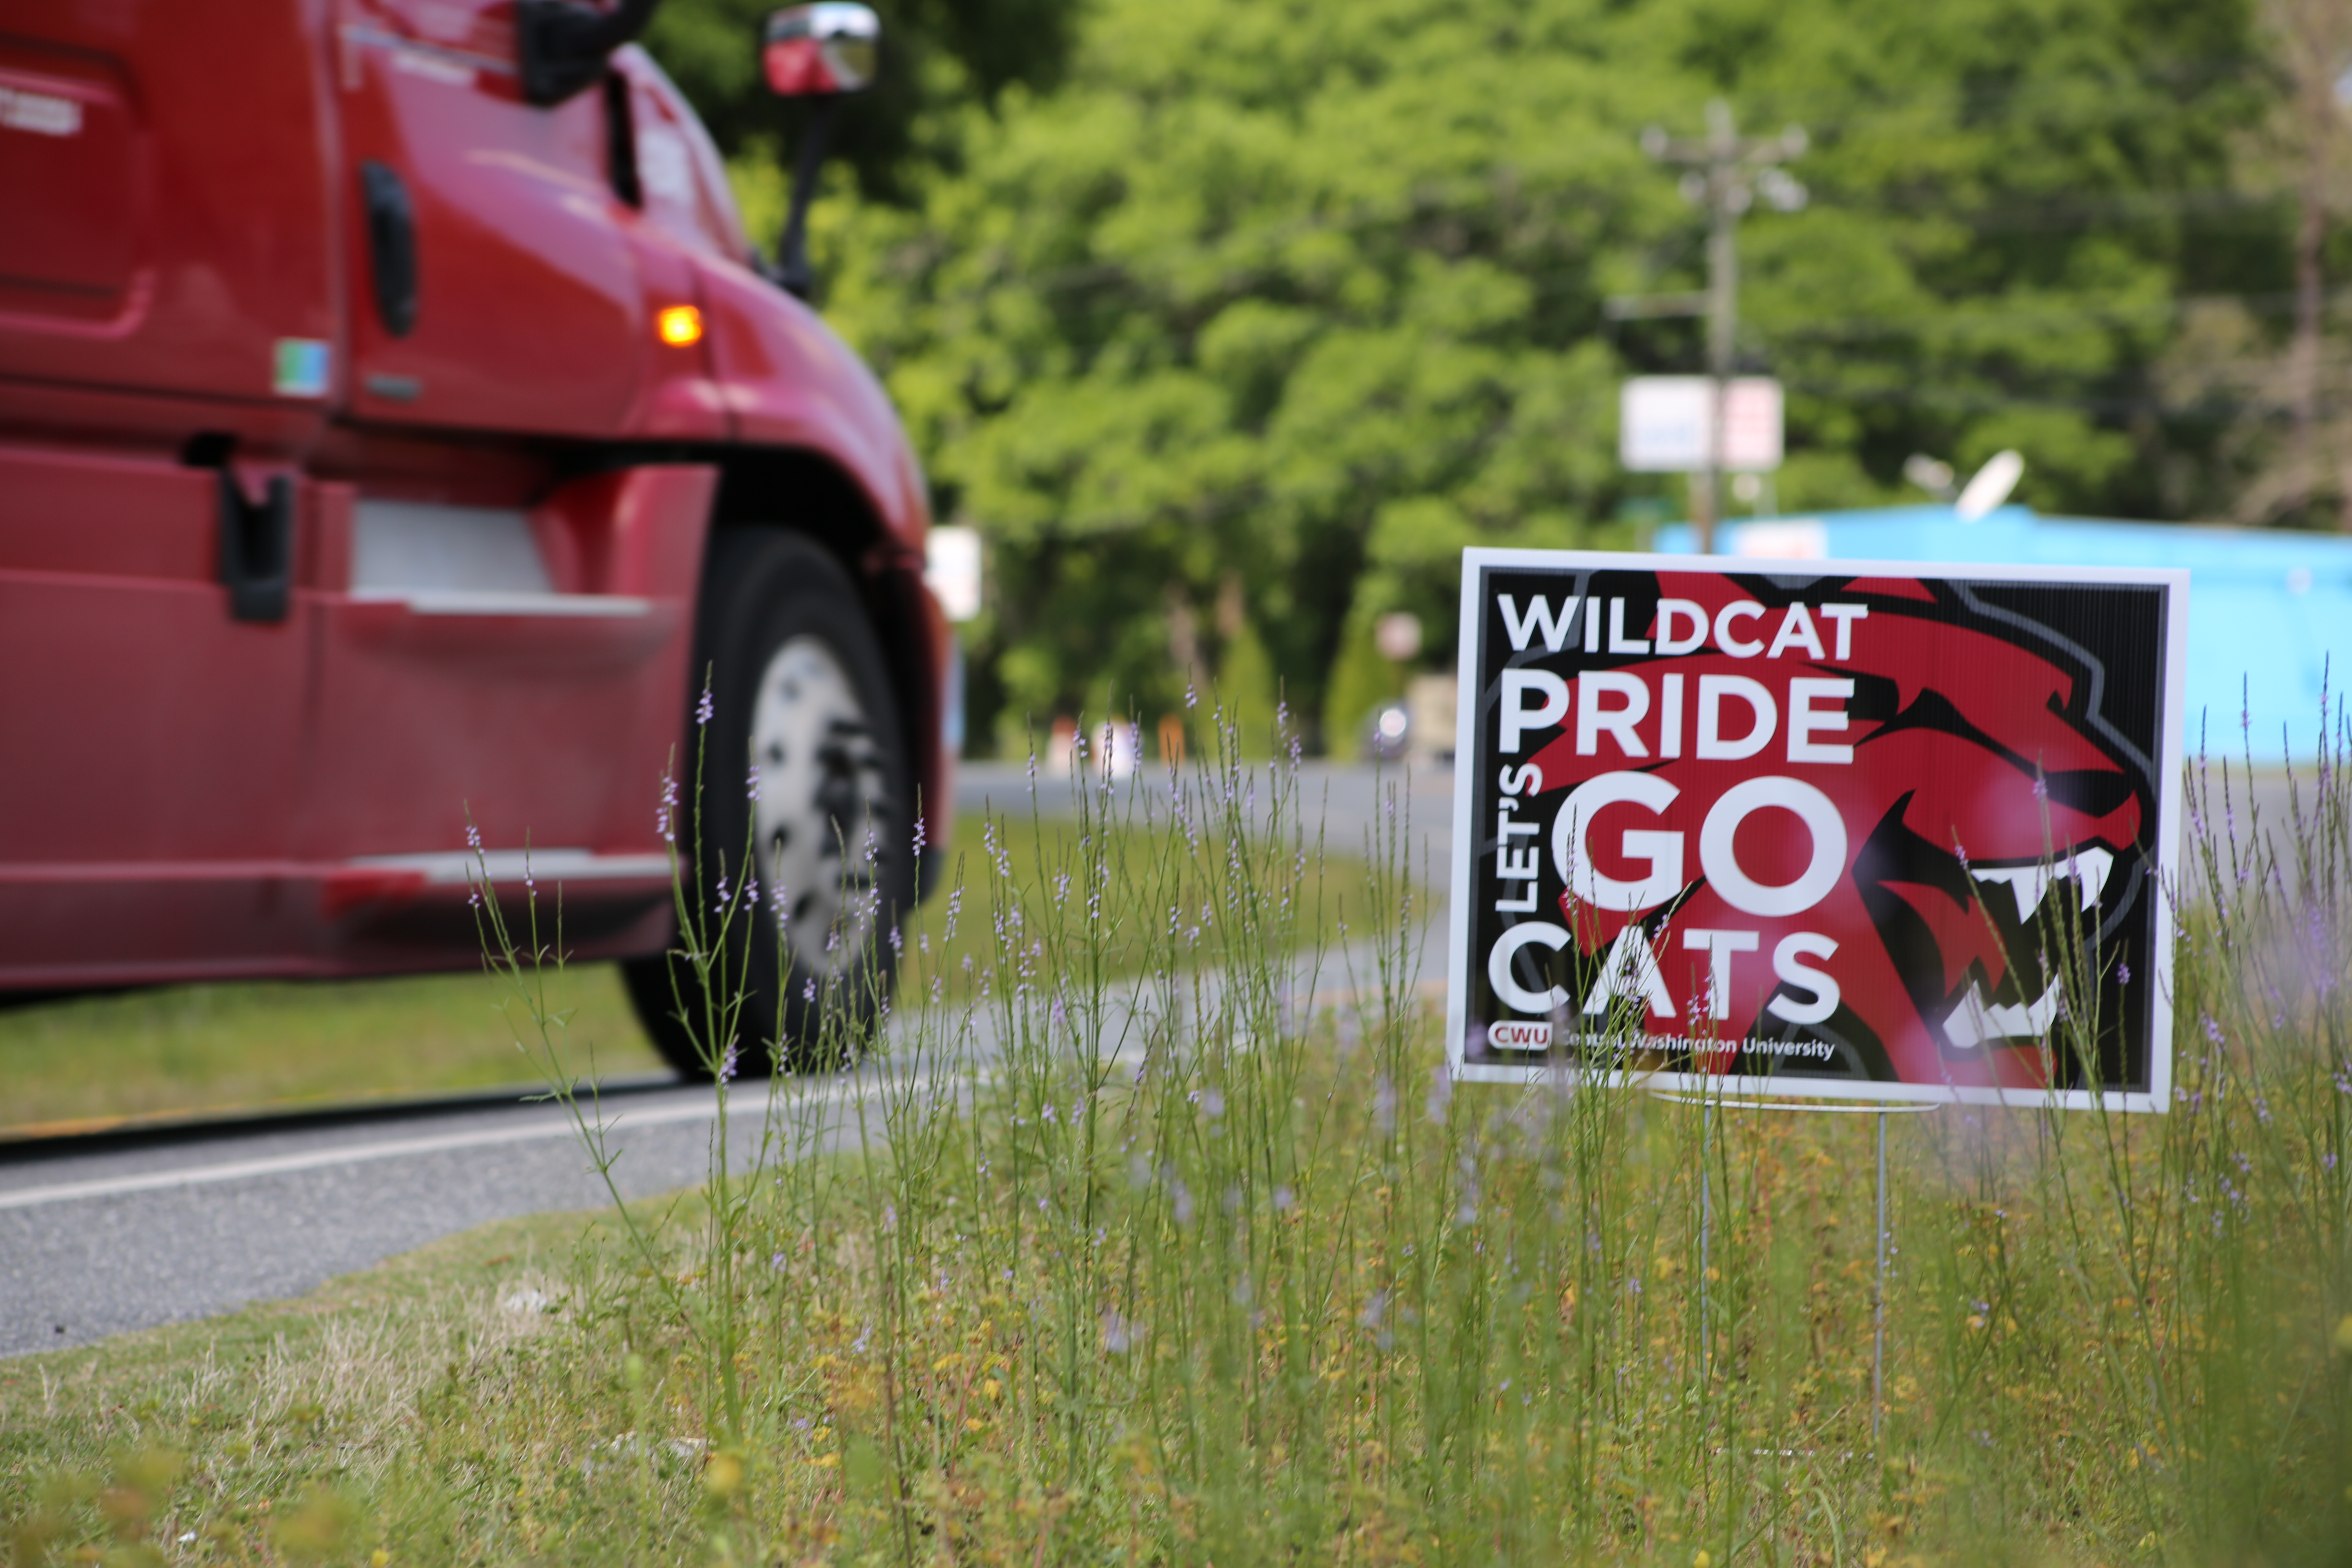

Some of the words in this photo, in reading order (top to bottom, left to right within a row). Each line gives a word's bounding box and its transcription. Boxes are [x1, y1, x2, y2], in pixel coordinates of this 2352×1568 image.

[1497, 594, 1868, 660] WILDCAT
[1499, 668, 1855, 764] PRIDE
[1495, 763, 1543, 913] LET'S
[1552, 771, 1848, 917] GO
[1488, 921, 1840, 1025] CATS
[1494, 1027, 1548, 1044] CWU
[1743, 1038, 1835, 1061] University
